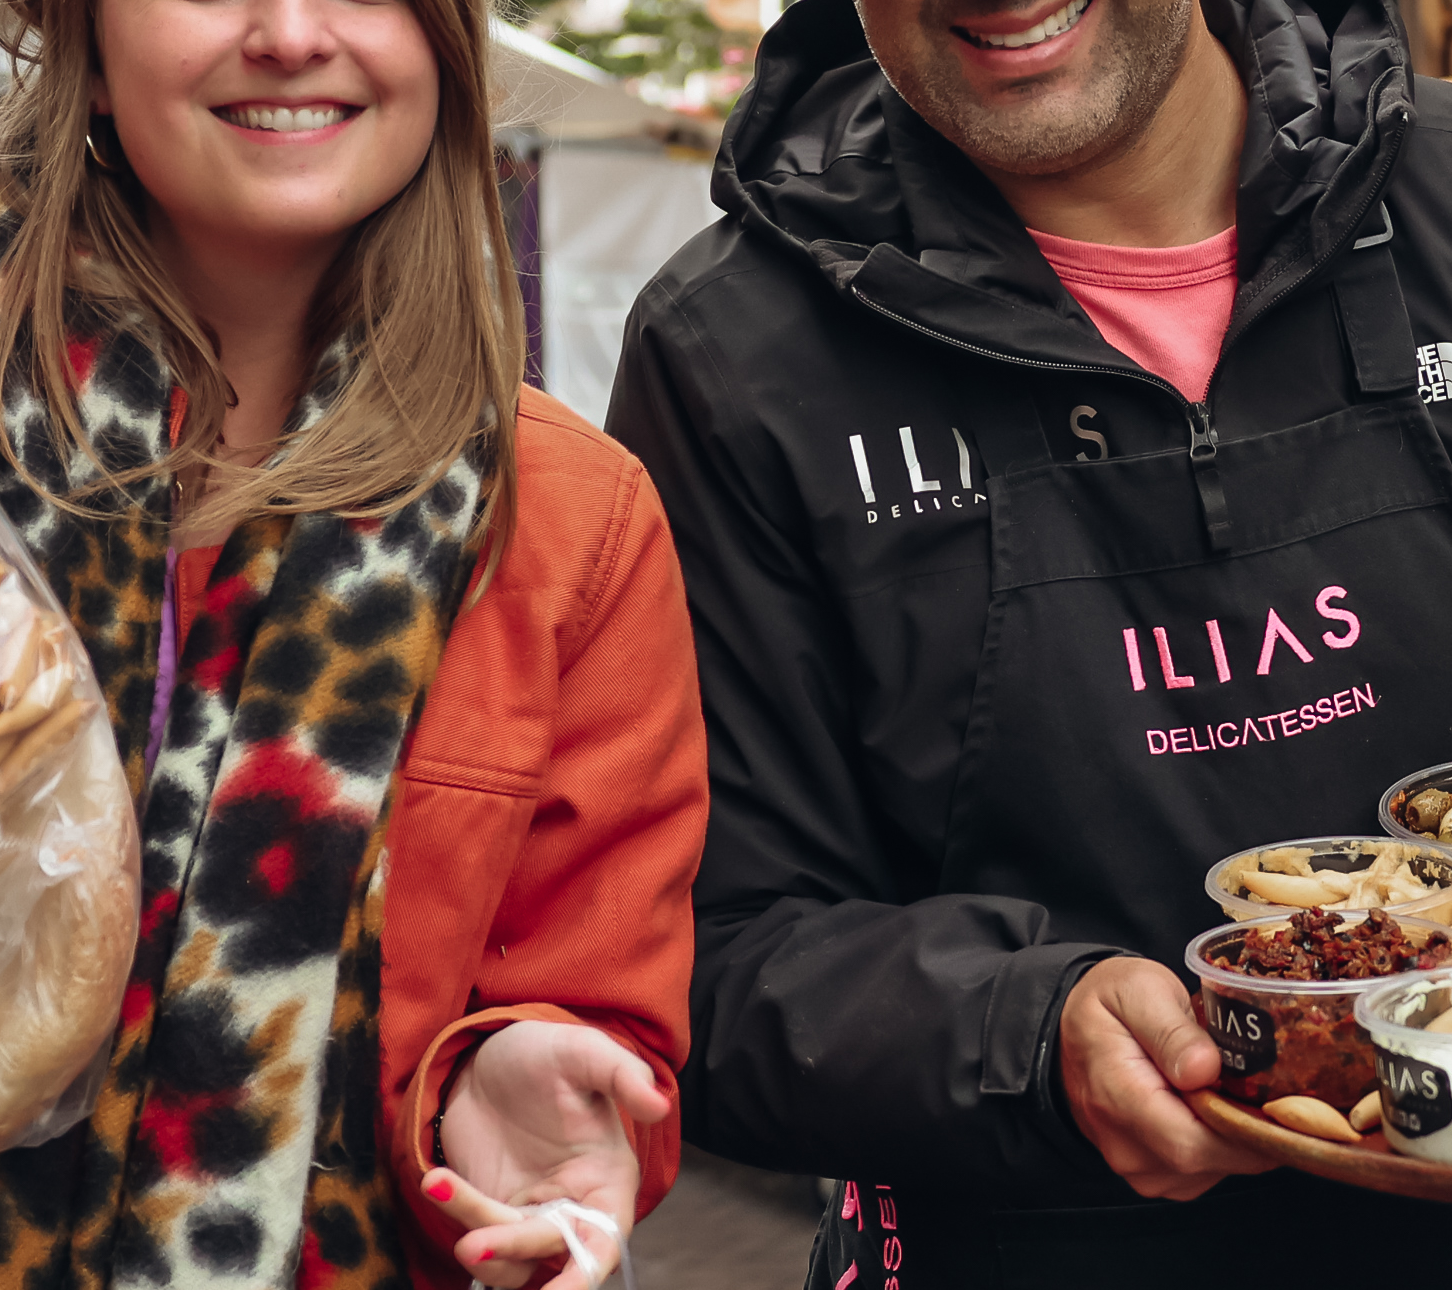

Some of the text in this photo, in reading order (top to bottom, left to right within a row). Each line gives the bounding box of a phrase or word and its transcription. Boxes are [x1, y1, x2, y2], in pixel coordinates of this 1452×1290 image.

[866, 492, 987, 524] DELICA
[1123, 585, 1362, 692] ILIAS
[1146, 683, 1377, 755] DELICATESSEN
